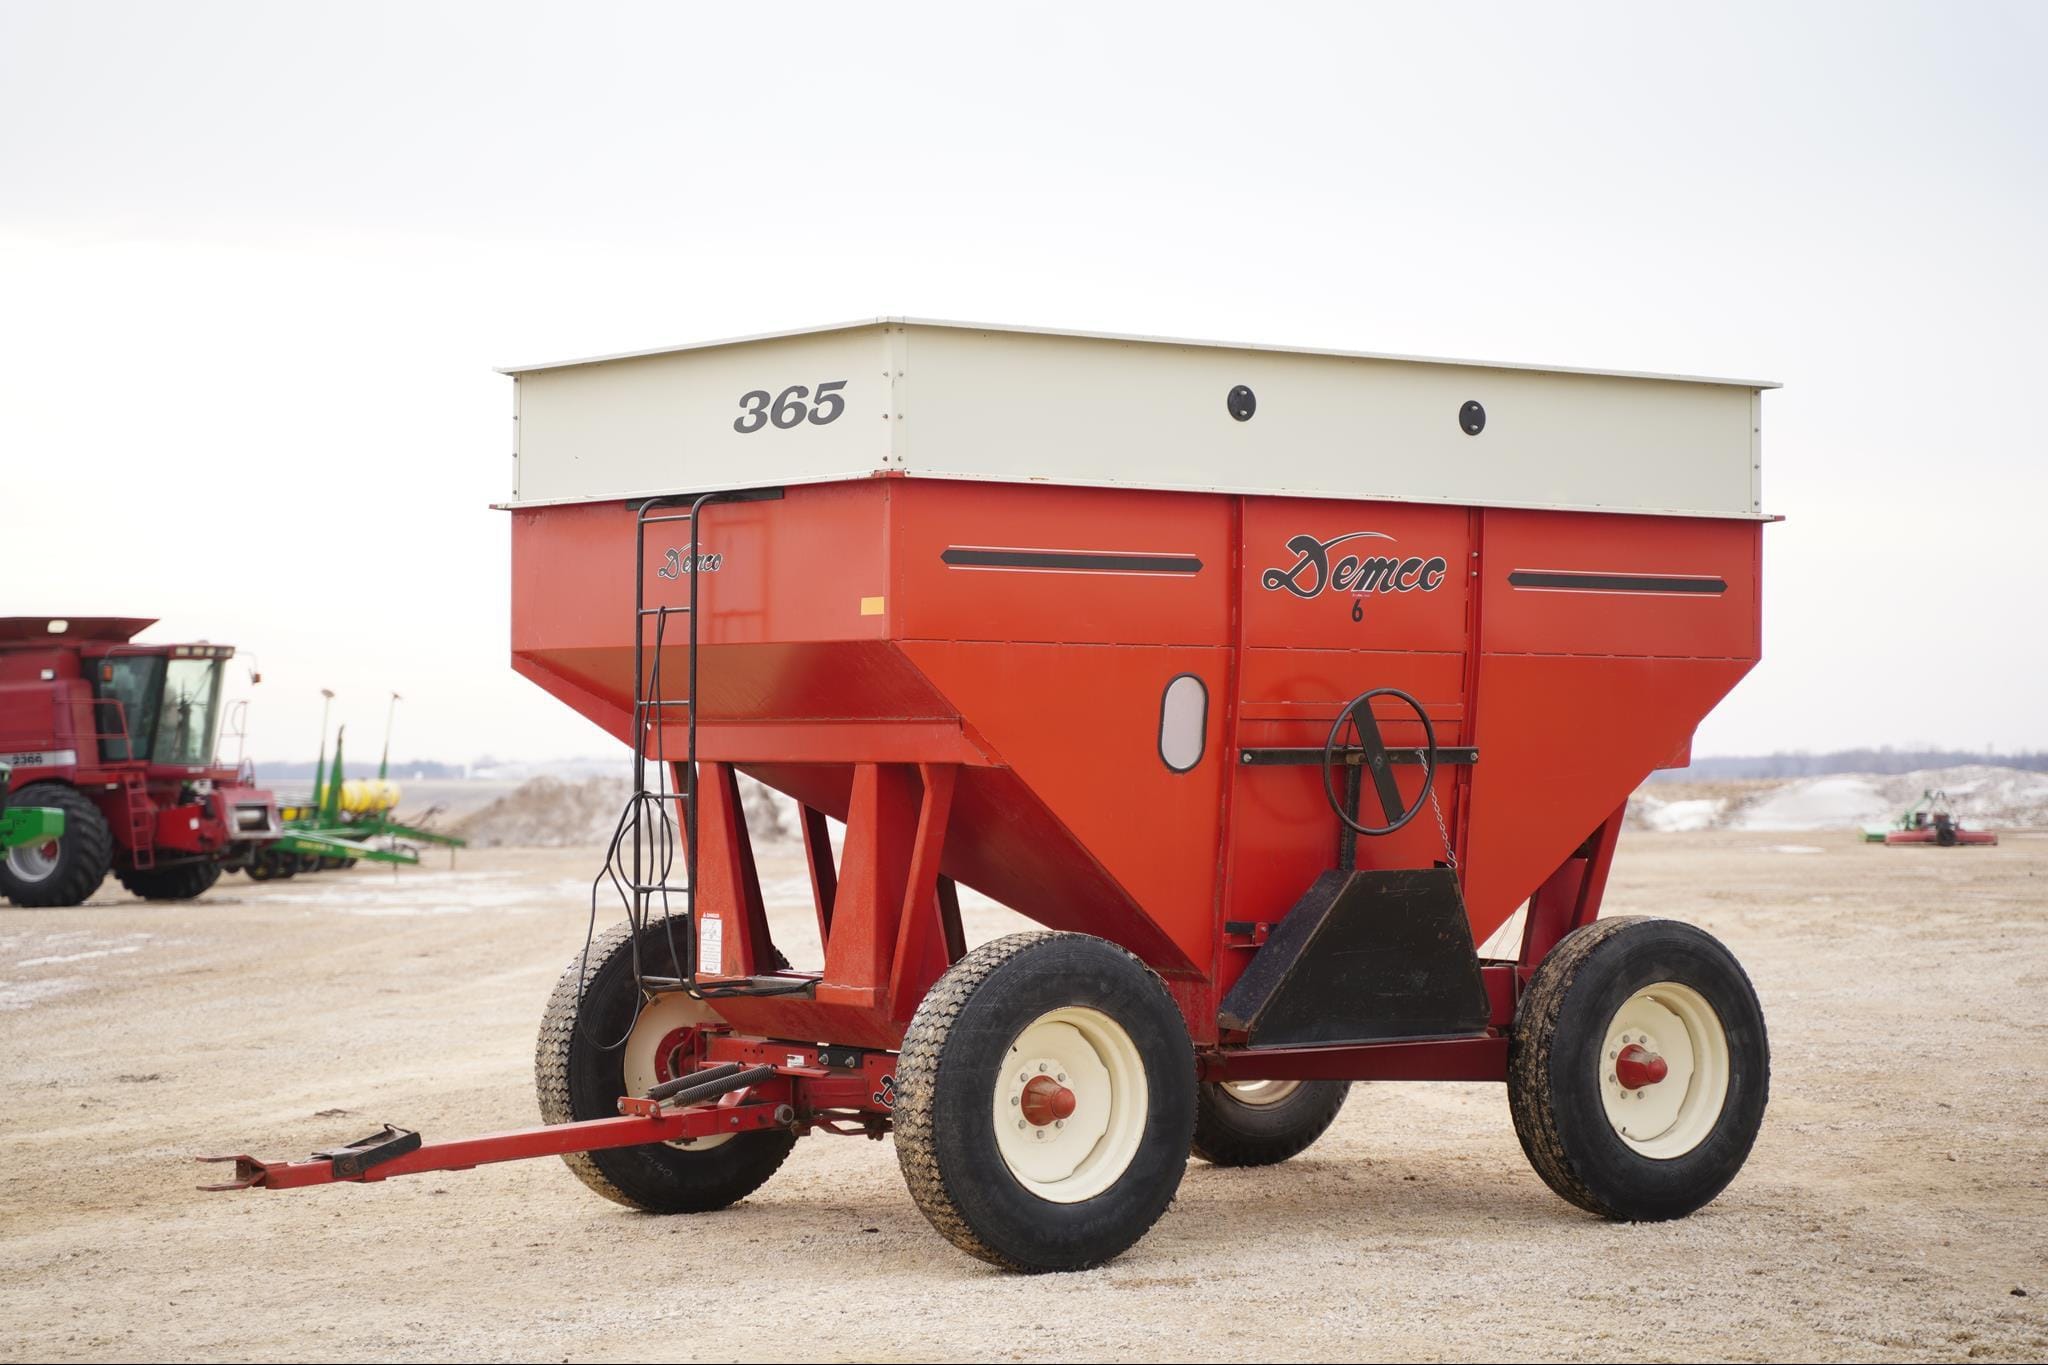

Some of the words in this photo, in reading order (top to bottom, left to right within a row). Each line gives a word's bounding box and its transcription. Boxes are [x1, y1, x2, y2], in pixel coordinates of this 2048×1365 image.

[733, 380, 848, 434] 365
[1262, 531, 1447, 599] Demco
[1351, 598, 1363, 622] 6
